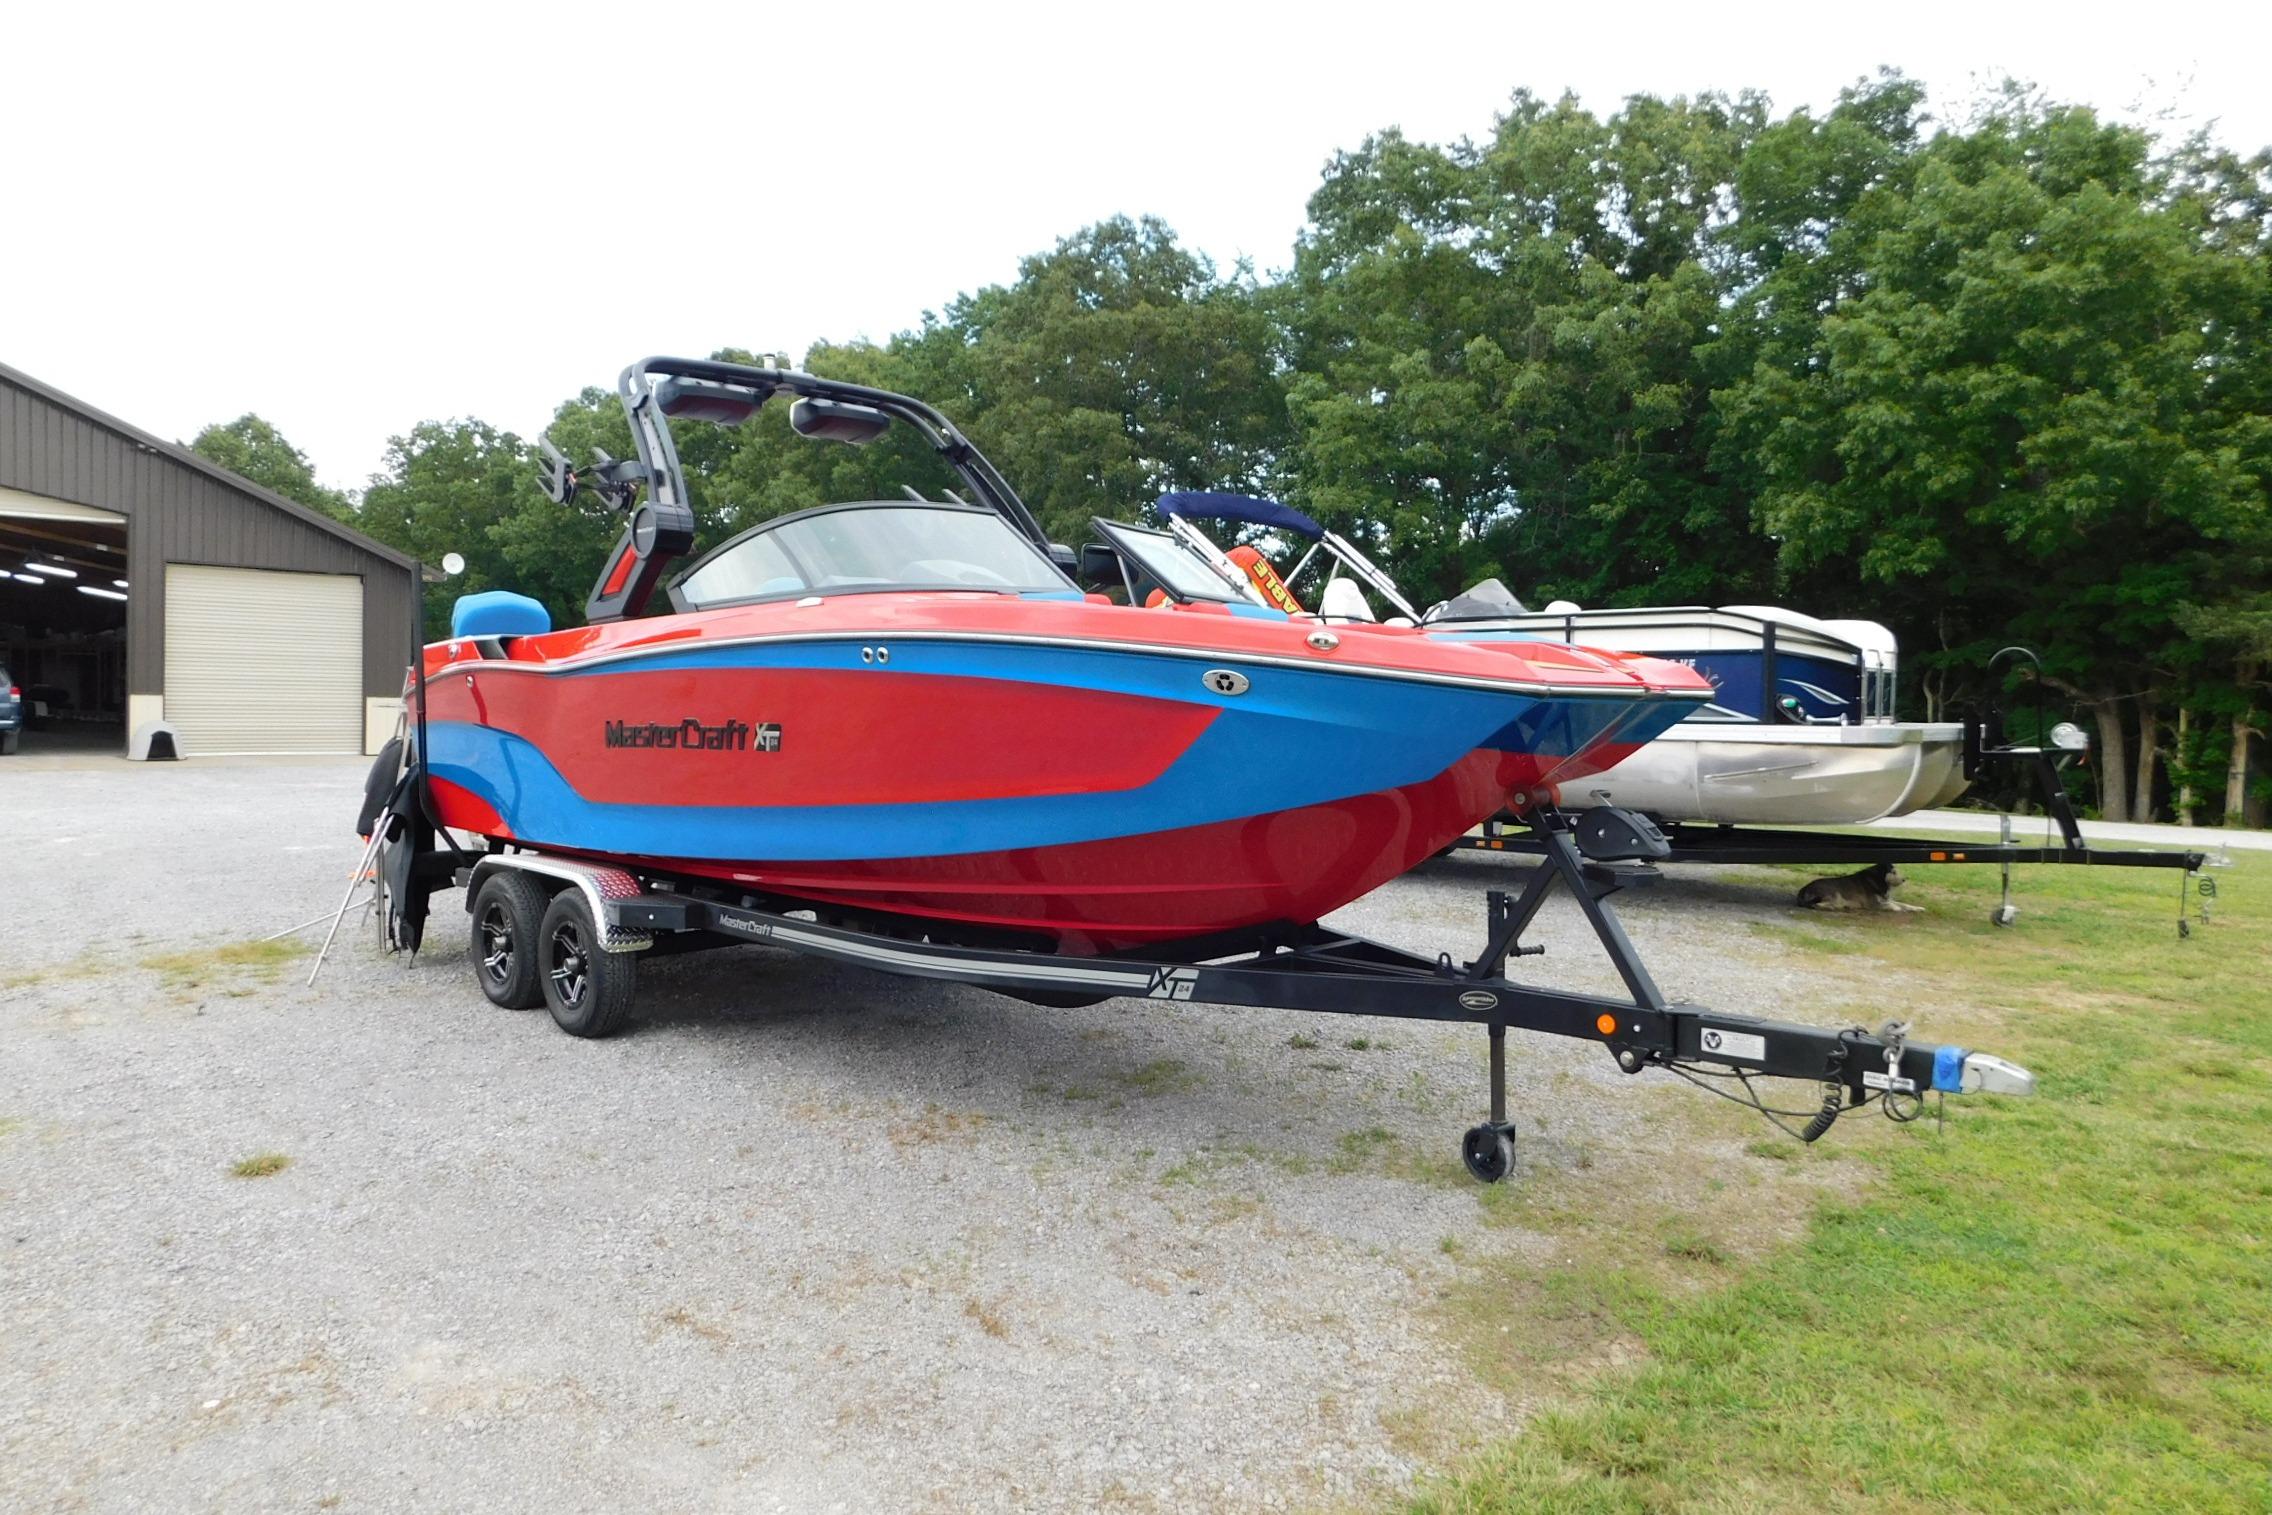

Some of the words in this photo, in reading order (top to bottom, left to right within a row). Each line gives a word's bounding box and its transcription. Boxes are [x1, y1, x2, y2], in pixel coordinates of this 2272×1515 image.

[1252, 559, 1300, 614] ABLE
[605, 715, 749, 750] MasterCraft
[719, 913, 772, 936] MasterCraft
